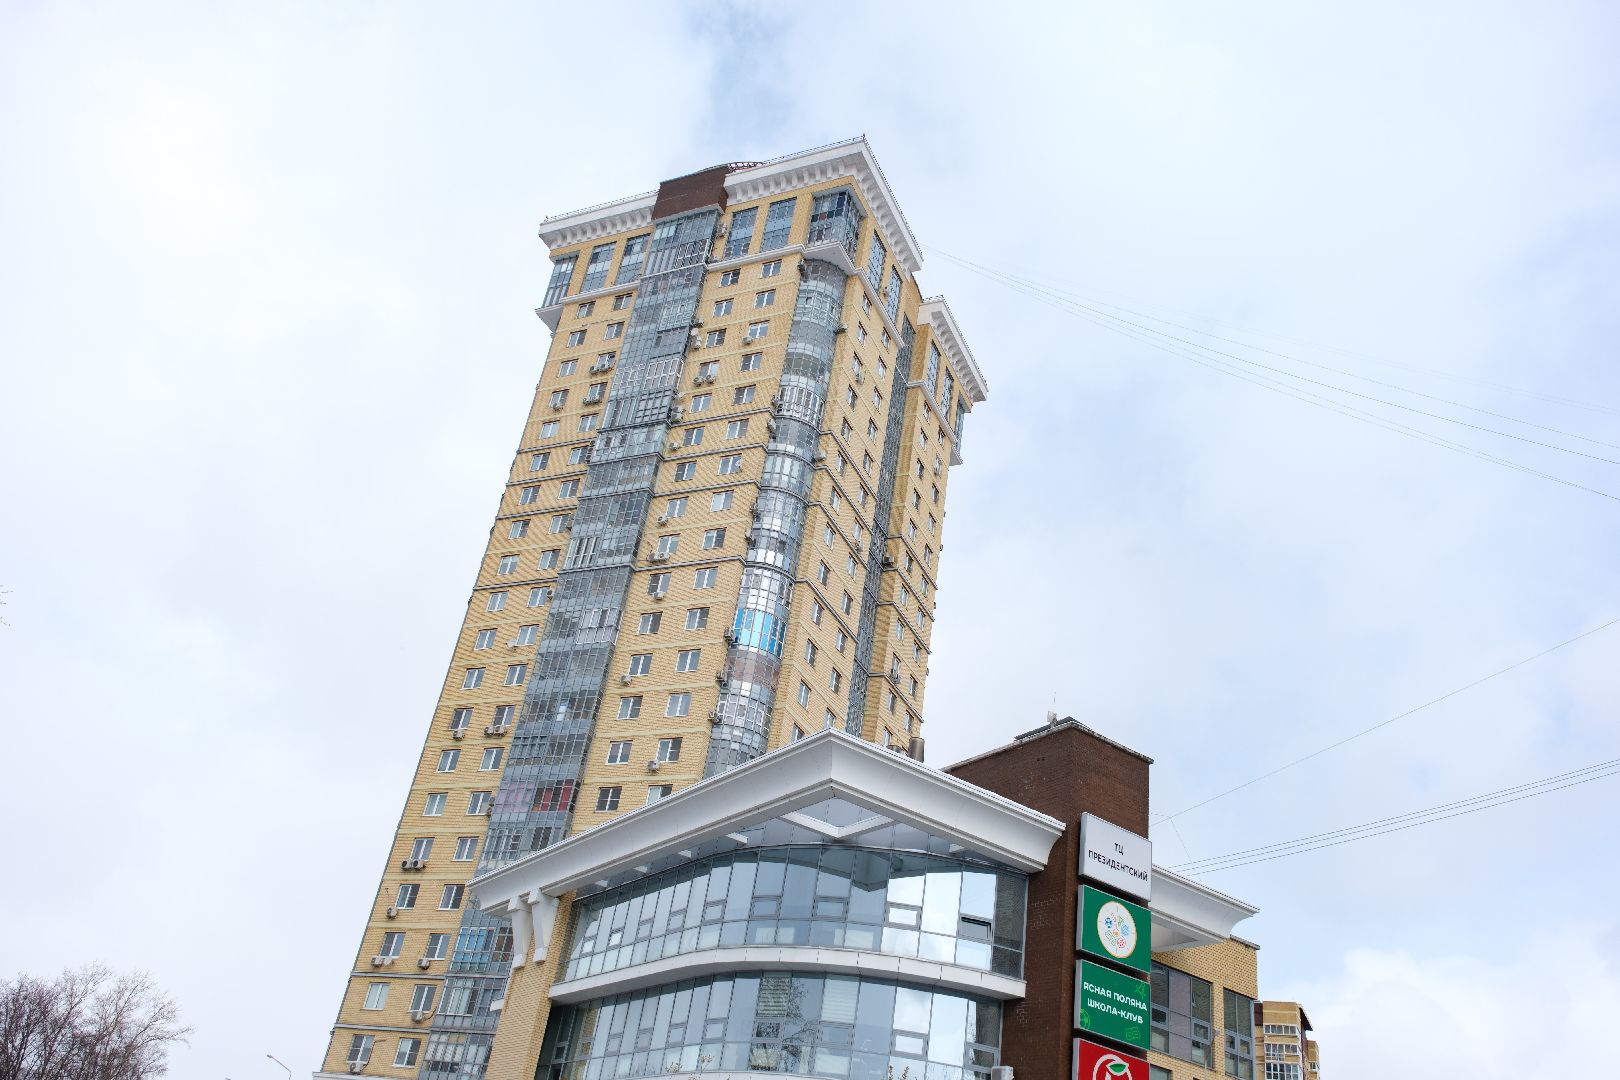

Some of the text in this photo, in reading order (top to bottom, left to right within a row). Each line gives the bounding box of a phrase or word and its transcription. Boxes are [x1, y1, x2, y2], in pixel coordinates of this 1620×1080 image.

[1114, 842, 1124, 855] ТЦ
[1088, 849, 1148, 881] ПРЕЗИДЕНТСКИЙ
[1083, 982, 1148, 1011] ЯСНАЯ ПОЛЯНА
[1087, 997, 1143, 1024] ШКОЛА-КЛУБ
